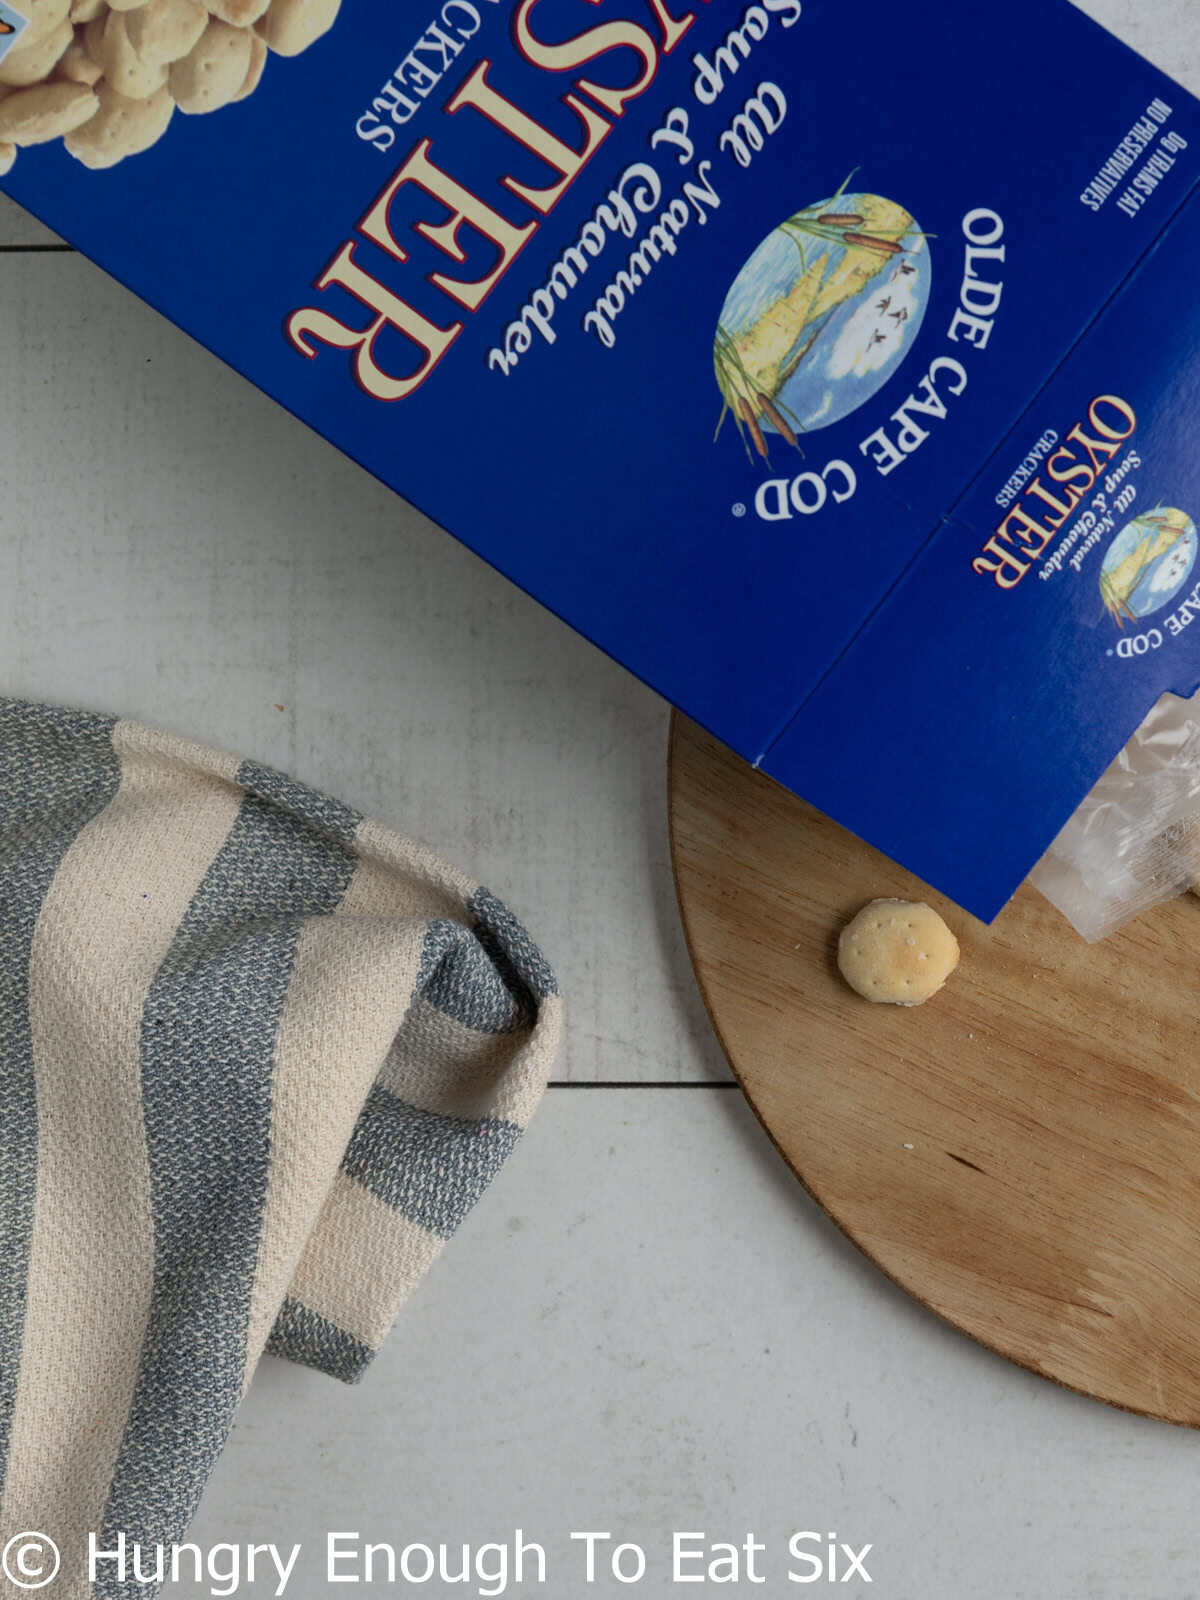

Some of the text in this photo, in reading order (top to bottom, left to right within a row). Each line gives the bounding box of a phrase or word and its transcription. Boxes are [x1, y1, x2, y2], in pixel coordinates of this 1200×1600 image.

[354, 0, 497, 152] CKERS
[652, 107, 694, 165] &
[584, 82, 787, 349] All Natural
[1080, 97, 1173, 212] NO PRESERVATIVES
[1116, 131, 1188, 218] 0g TRANS FAT
[488, 163, 662, 376] Chowder
[946, 207, 1006, 350] OLDE
[859, 356, 968, 476] CAPE
[995, 428, 1059, 509] CRACKERS
[971, 394, 1138, 590] OYSTER
[1038, 450, 1141, 581] Soup & Chowder
[1069, 484, 1137, 572] All Natural
